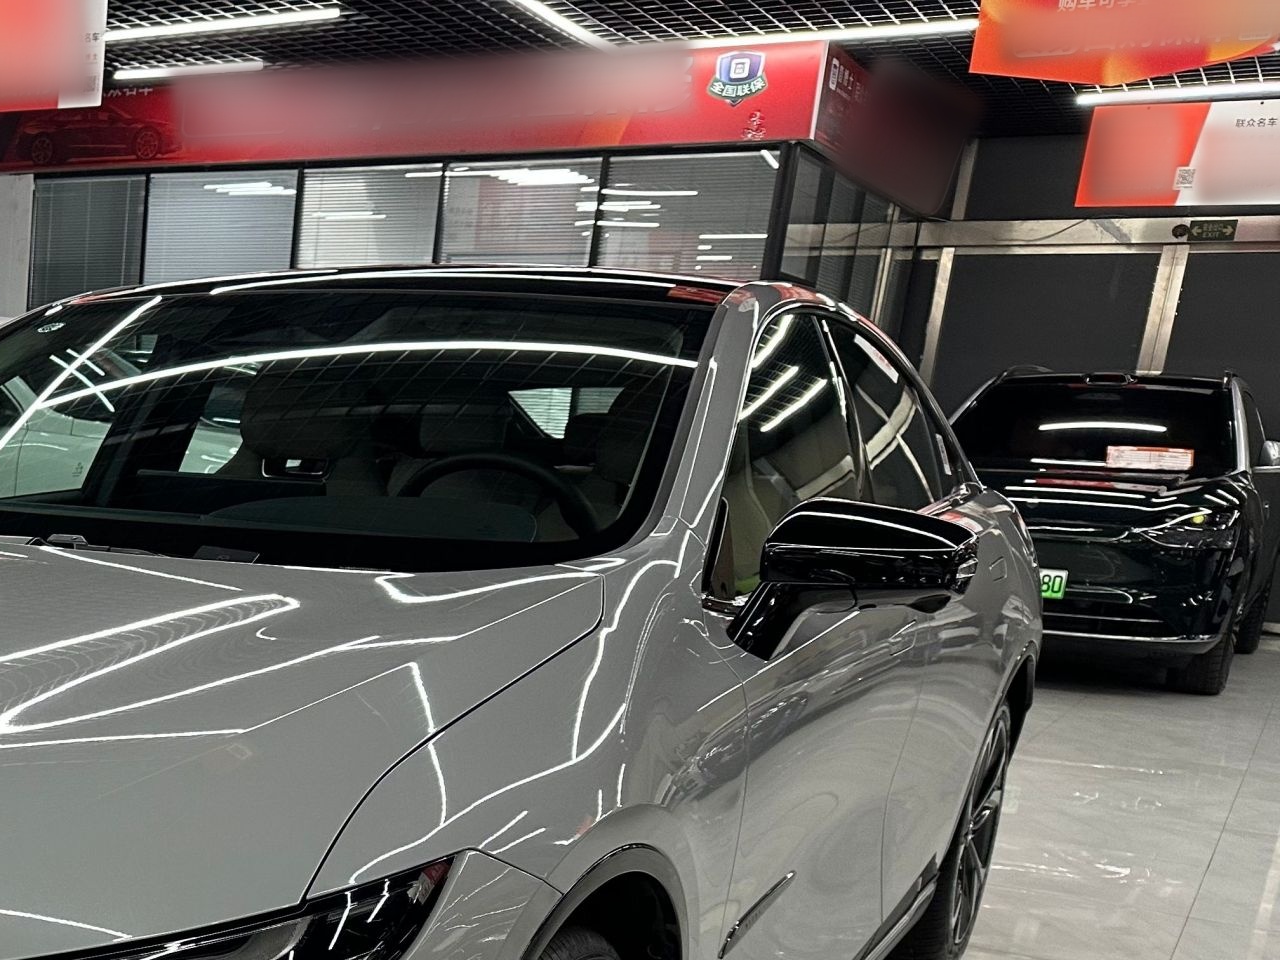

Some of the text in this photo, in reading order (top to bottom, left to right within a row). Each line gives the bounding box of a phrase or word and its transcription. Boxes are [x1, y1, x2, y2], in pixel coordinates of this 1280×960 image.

[710, 78, 766, 97] 全国联保
[1235, 117, 1278, 128] 联众名车
